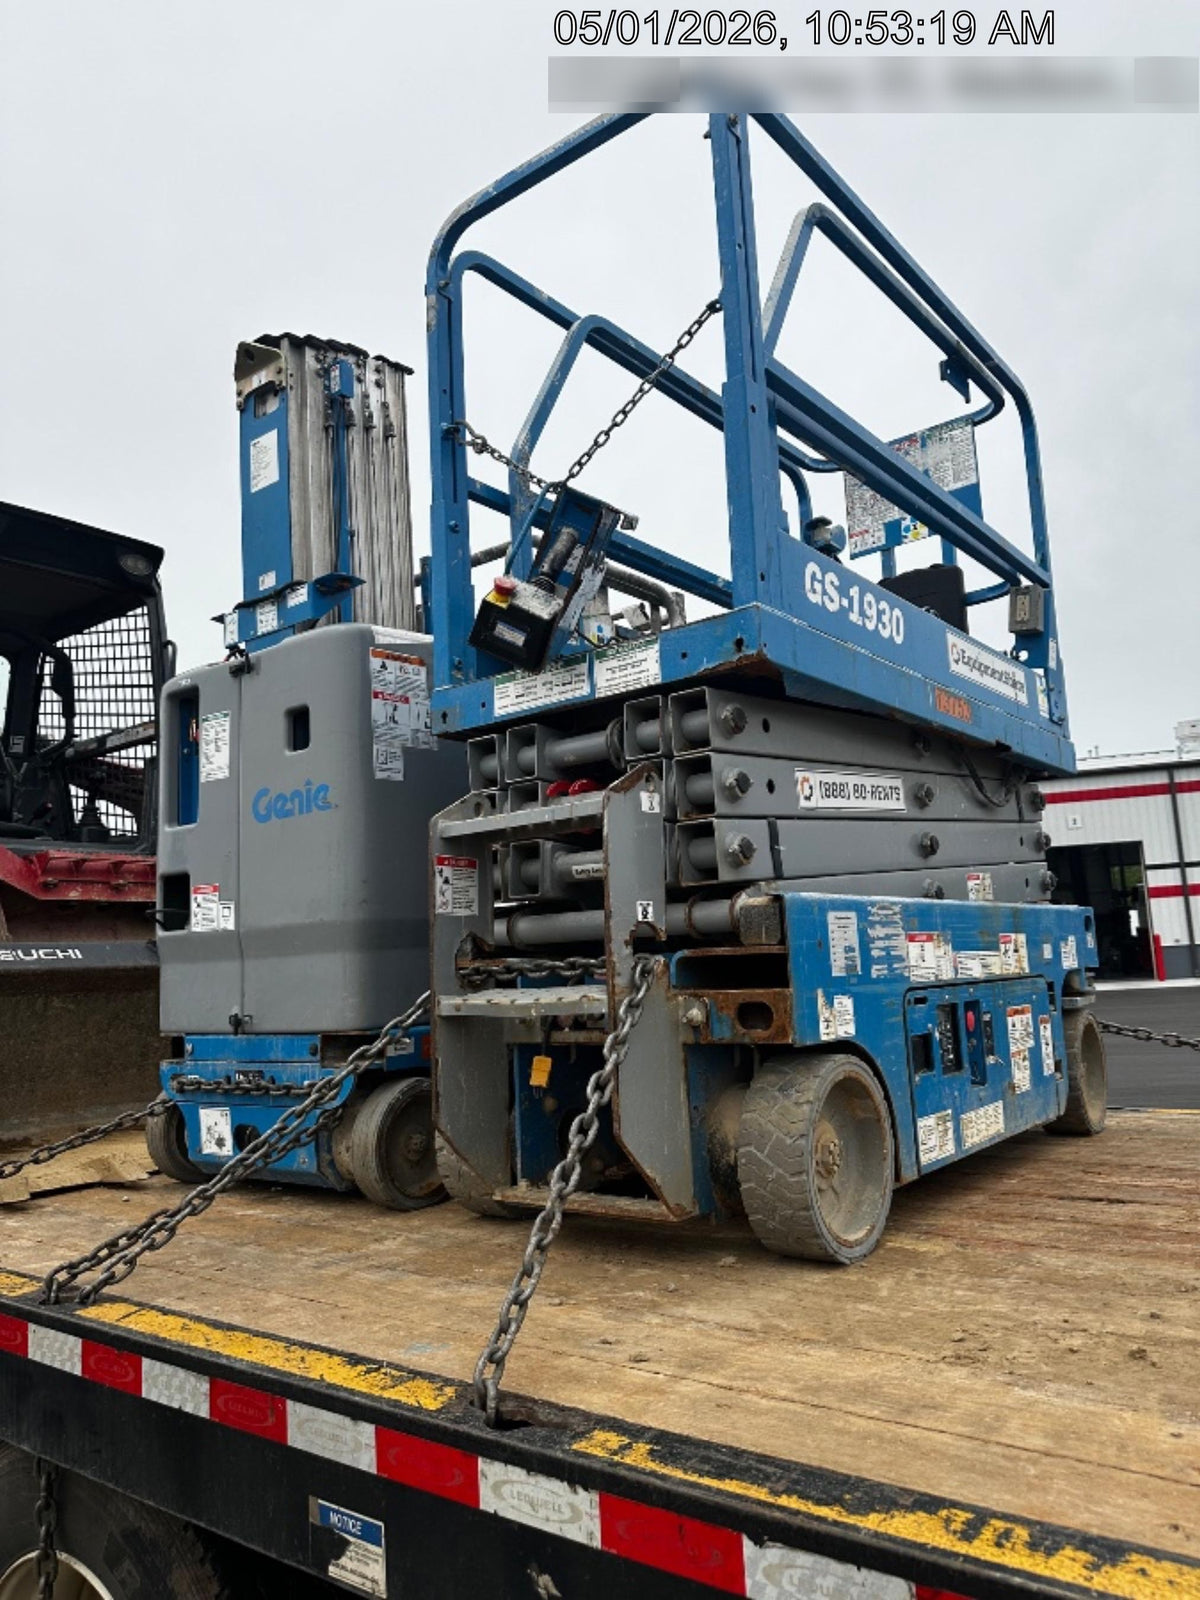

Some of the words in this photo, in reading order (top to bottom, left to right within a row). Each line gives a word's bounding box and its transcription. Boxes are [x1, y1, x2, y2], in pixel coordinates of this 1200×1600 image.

[805, 561, 904, 645] GS-1930
[252, 777, 333, 823] Genie
[819, 780, 850, 800] (888)
[330, 1510, 362, 1535] NOTICE
